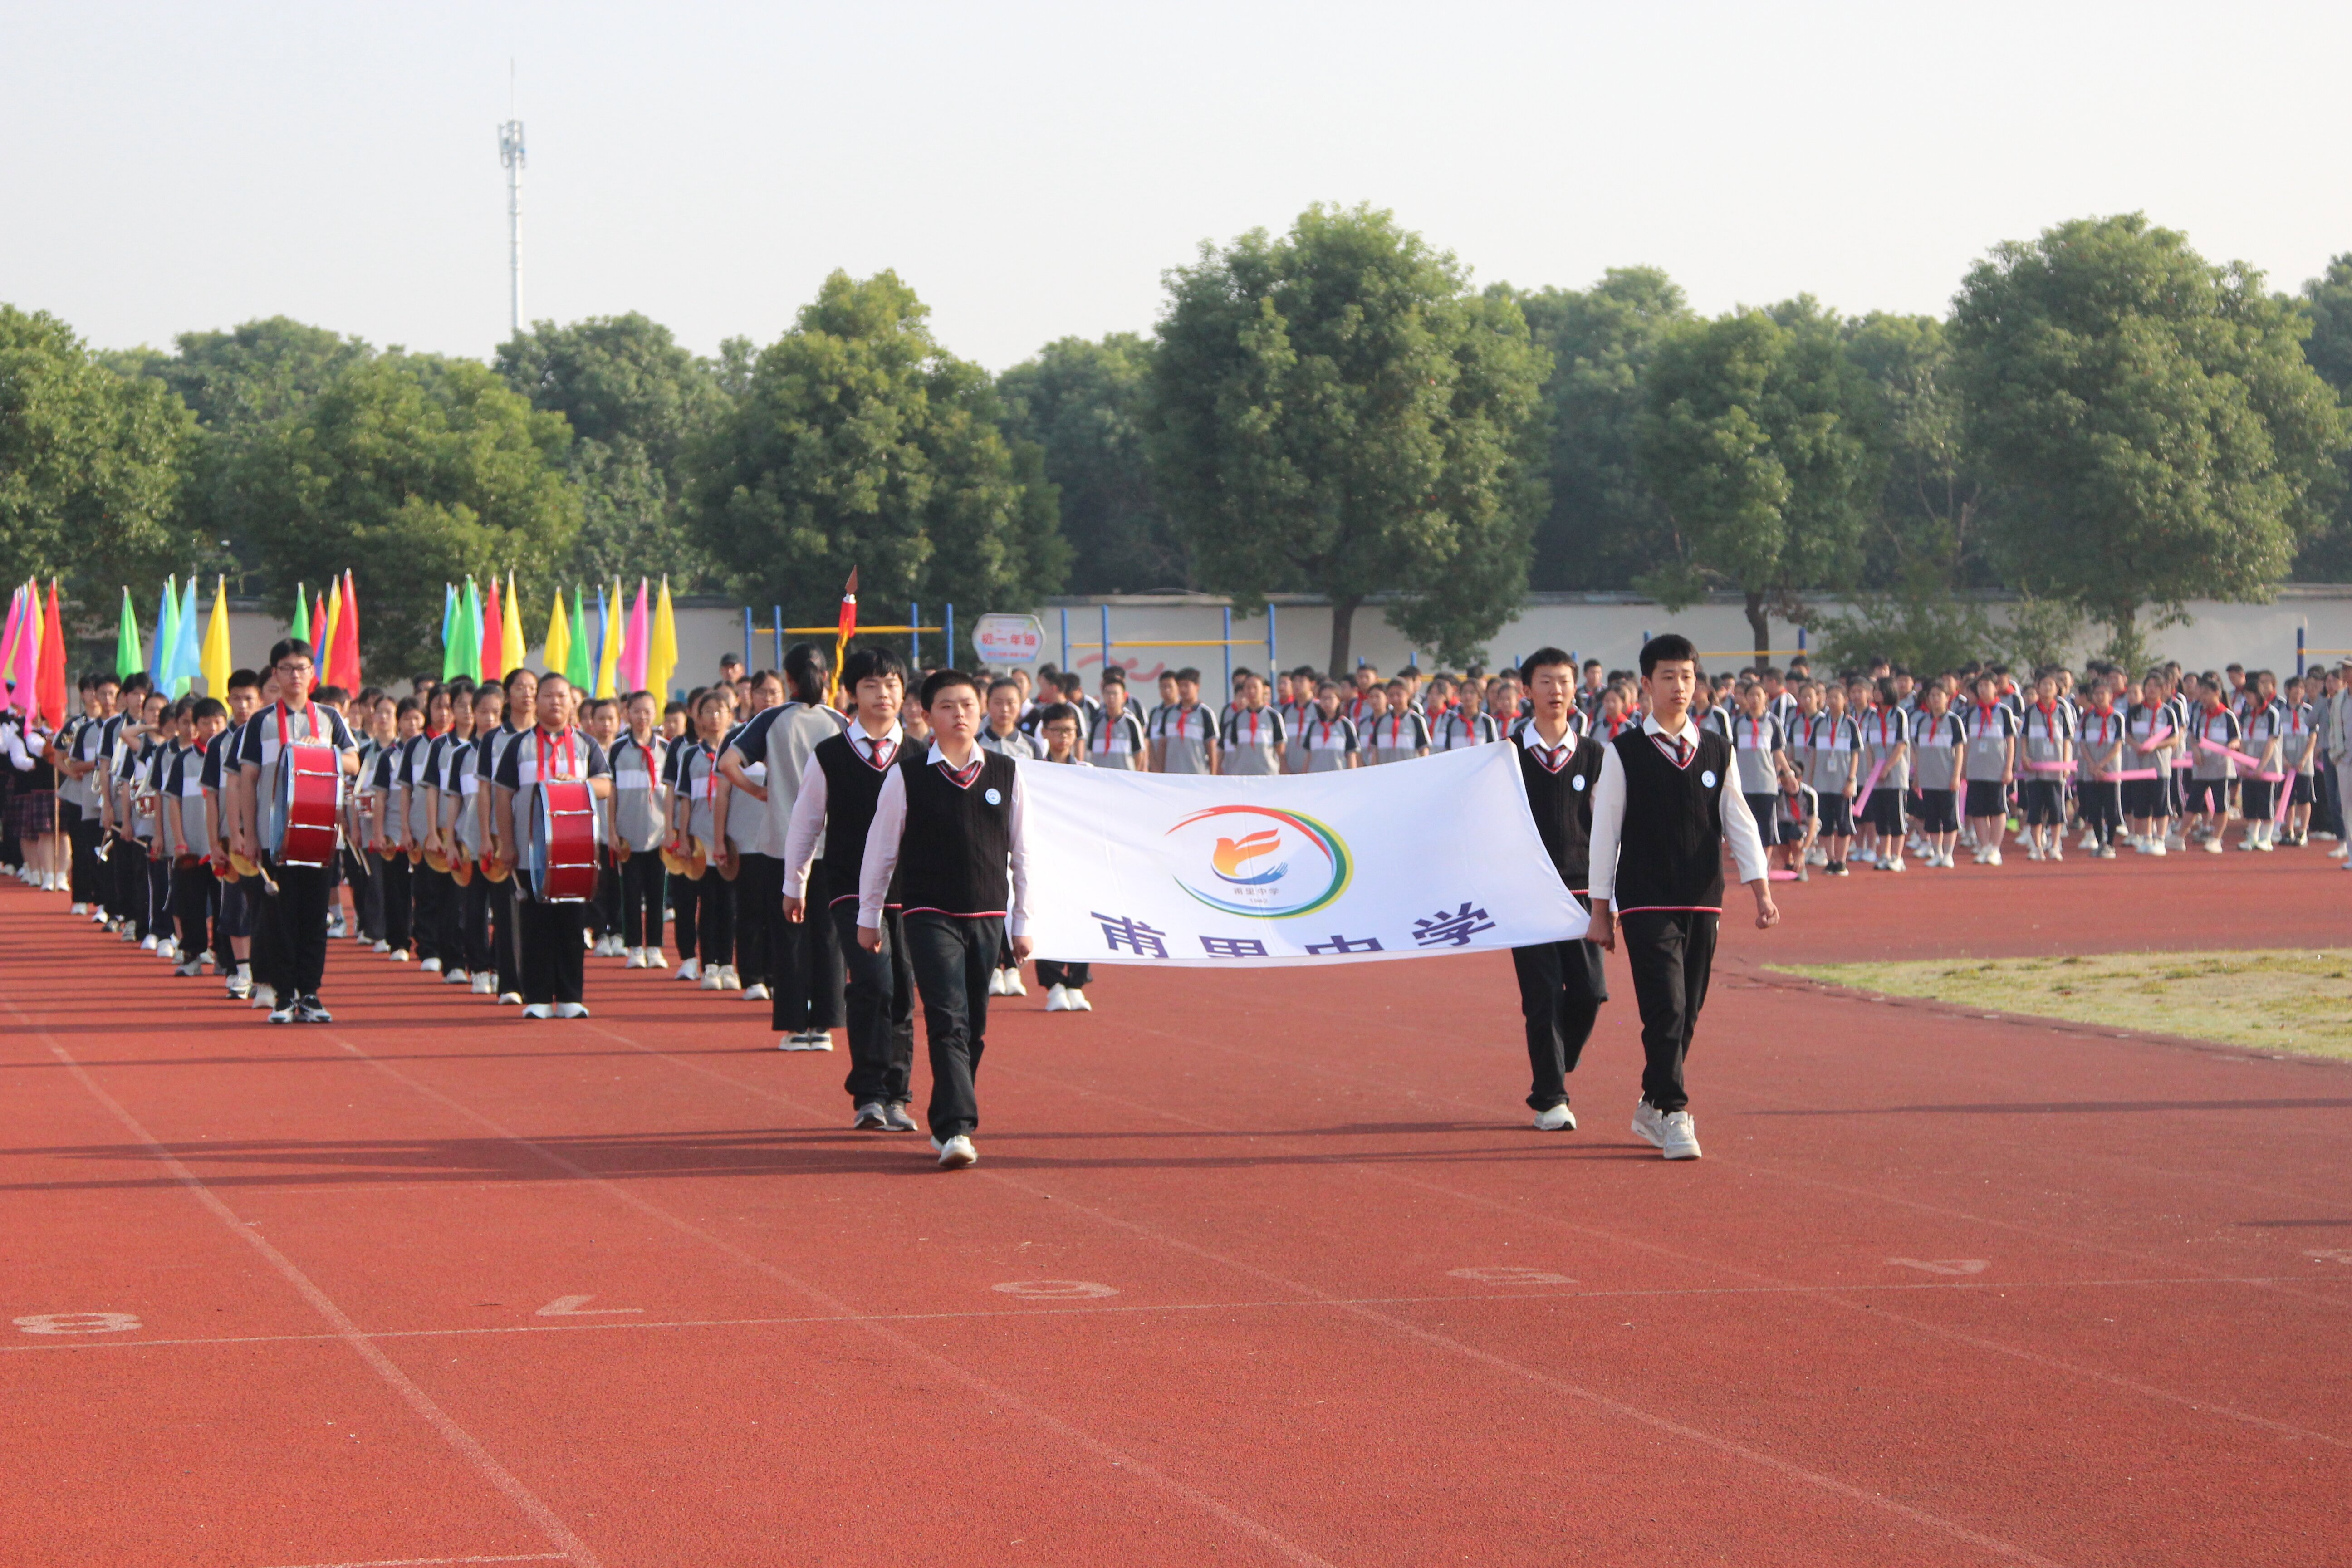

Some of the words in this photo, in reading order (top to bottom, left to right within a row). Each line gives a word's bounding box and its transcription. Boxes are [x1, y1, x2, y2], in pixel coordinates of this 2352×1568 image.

[982, 633, 1036, 646] 初一年级
[1090, 902, 1496, 959] 甫里中学
[12, 1312, 143, 1334] 8
